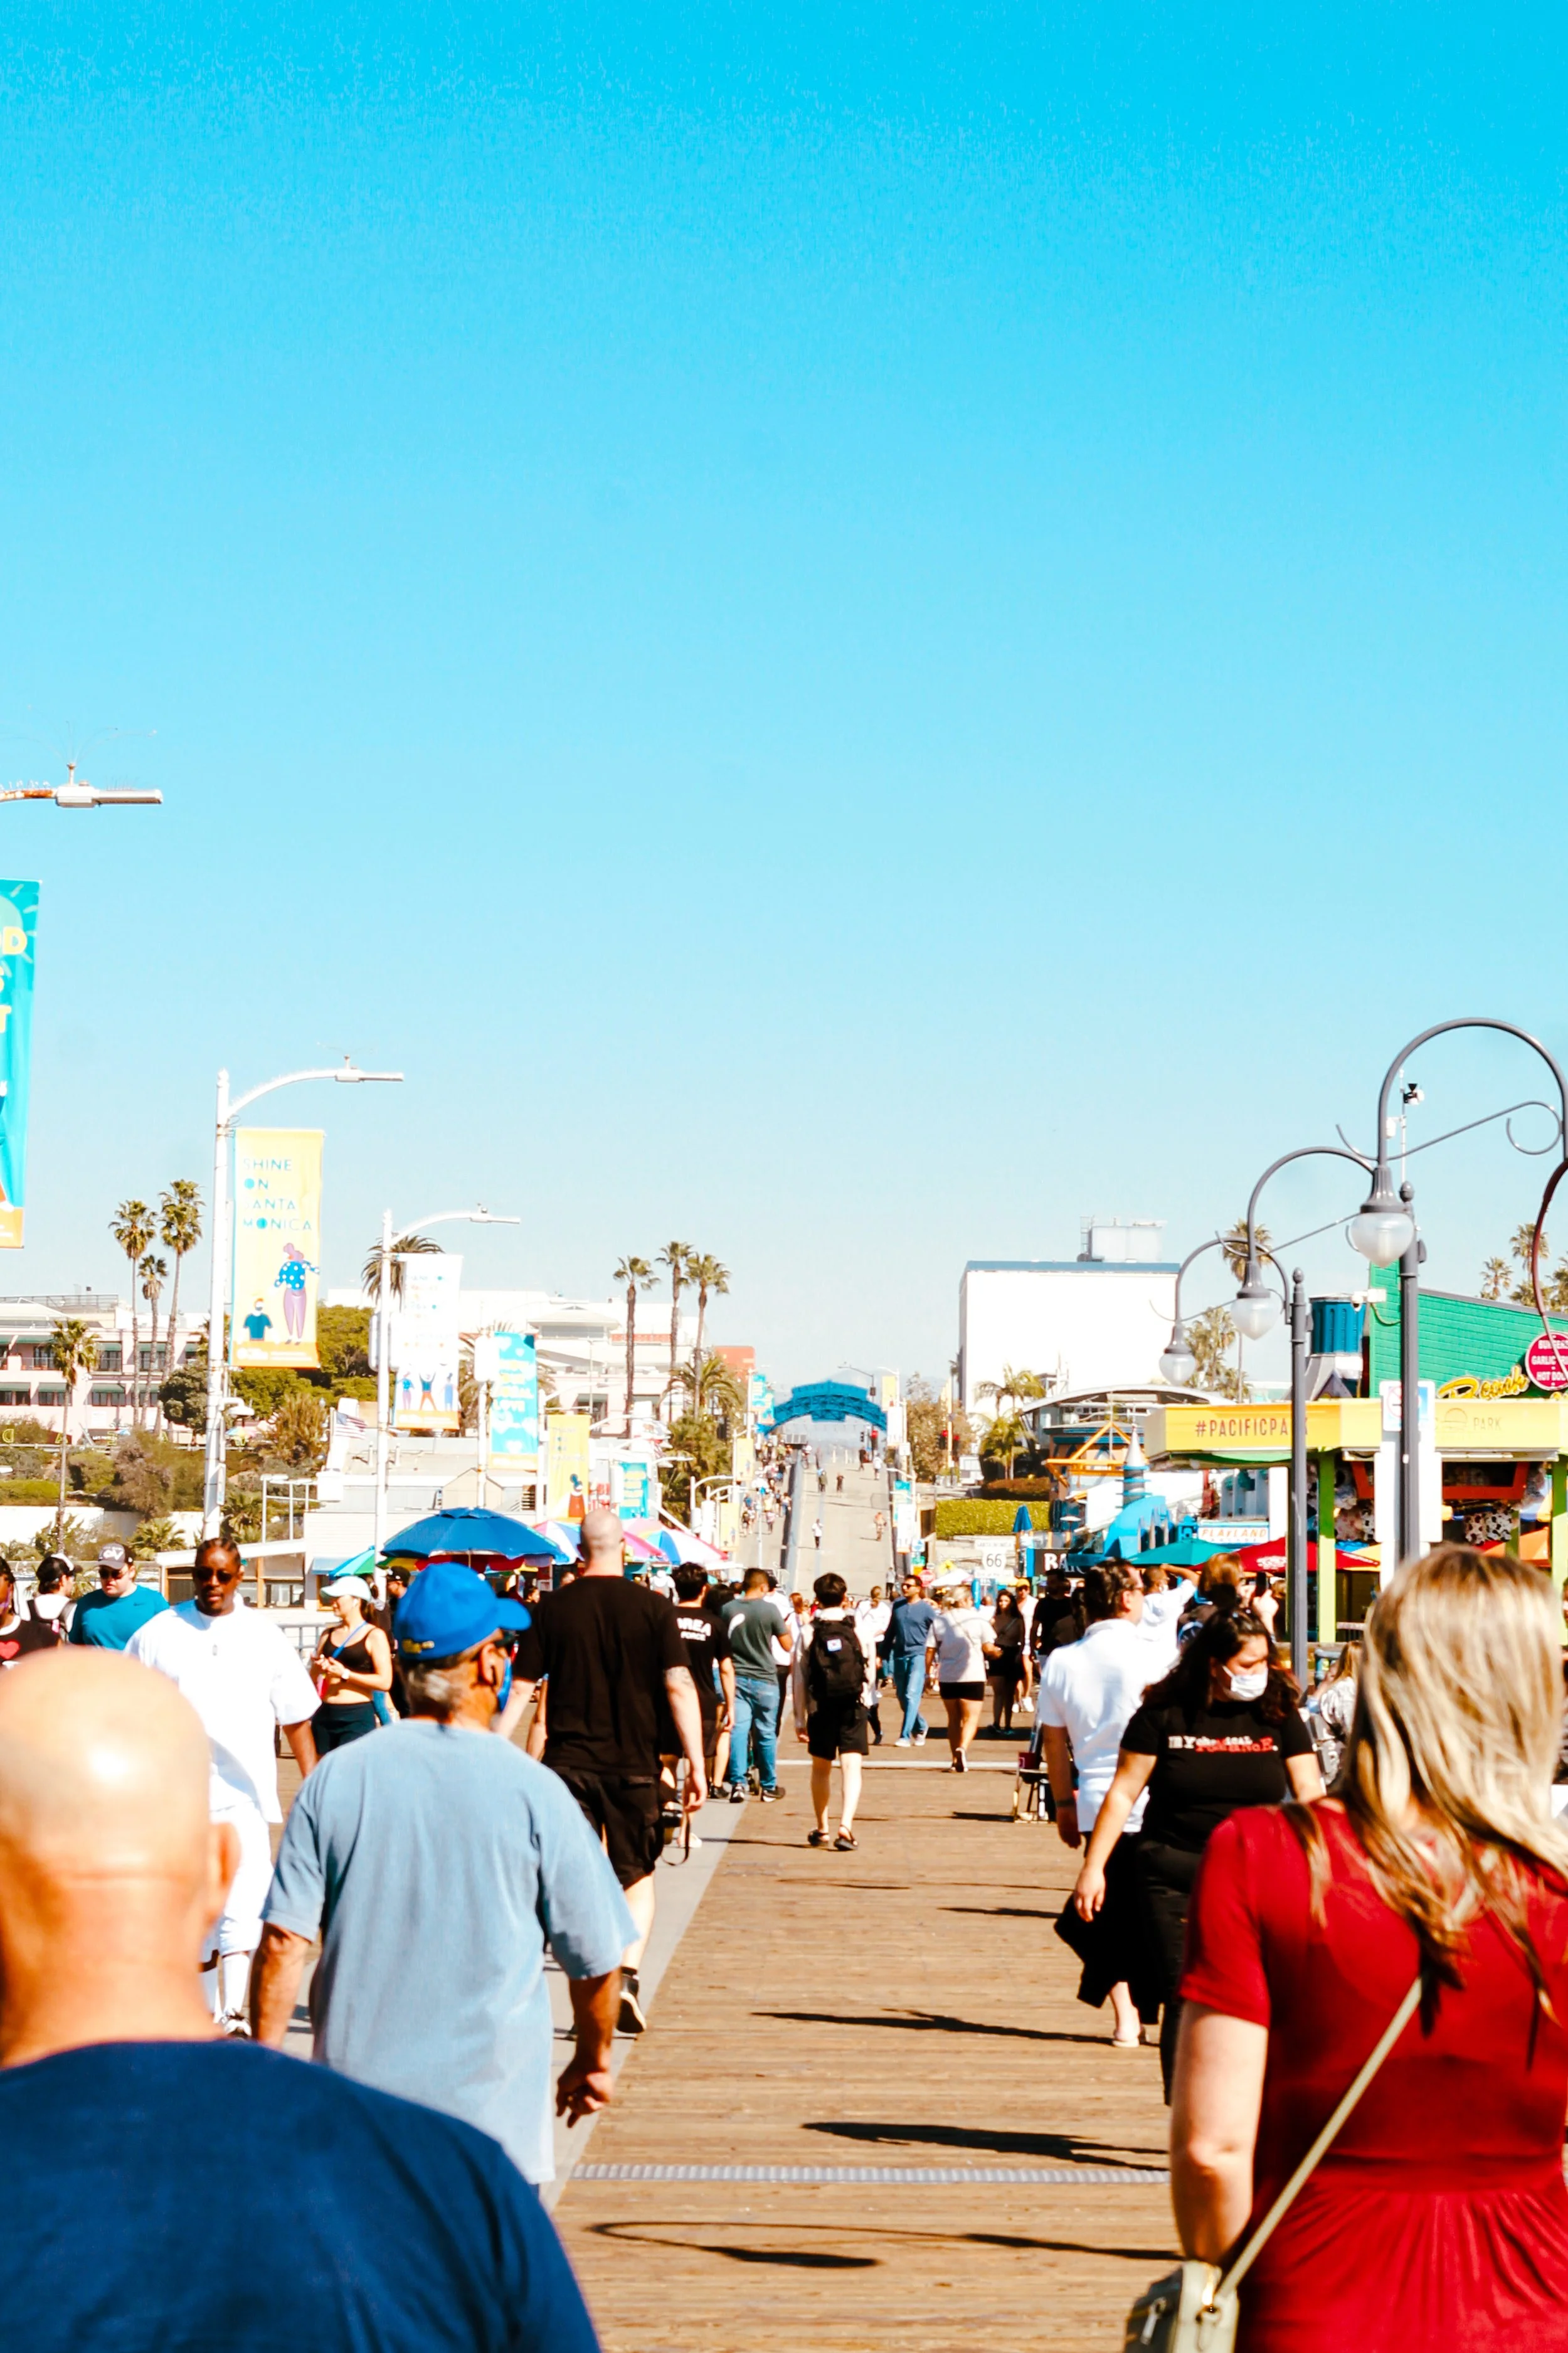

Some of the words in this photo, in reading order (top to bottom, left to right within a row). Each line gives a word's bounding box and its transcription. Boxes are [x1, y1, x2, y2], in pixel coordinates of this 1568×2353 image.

[243, 1158, 292, 1171] SHINE
[243, 1177, 269, 1191] ON
[243, 1197, 297, 1210] SANTA
[243, 1217, 312, 1231] MONICA
[1532, 1356, 1557, 1365] GARLIC
[1536, 1371, 1551, 1381] HOT
[1195, 1418, 1308, 1437] #PACIFICPA
[1473, 1416, 1502, 1431] PARK
[1201, 1528, 1267, 1538] PLAYLAND
[986, 1553, 1002, 1568] 66
